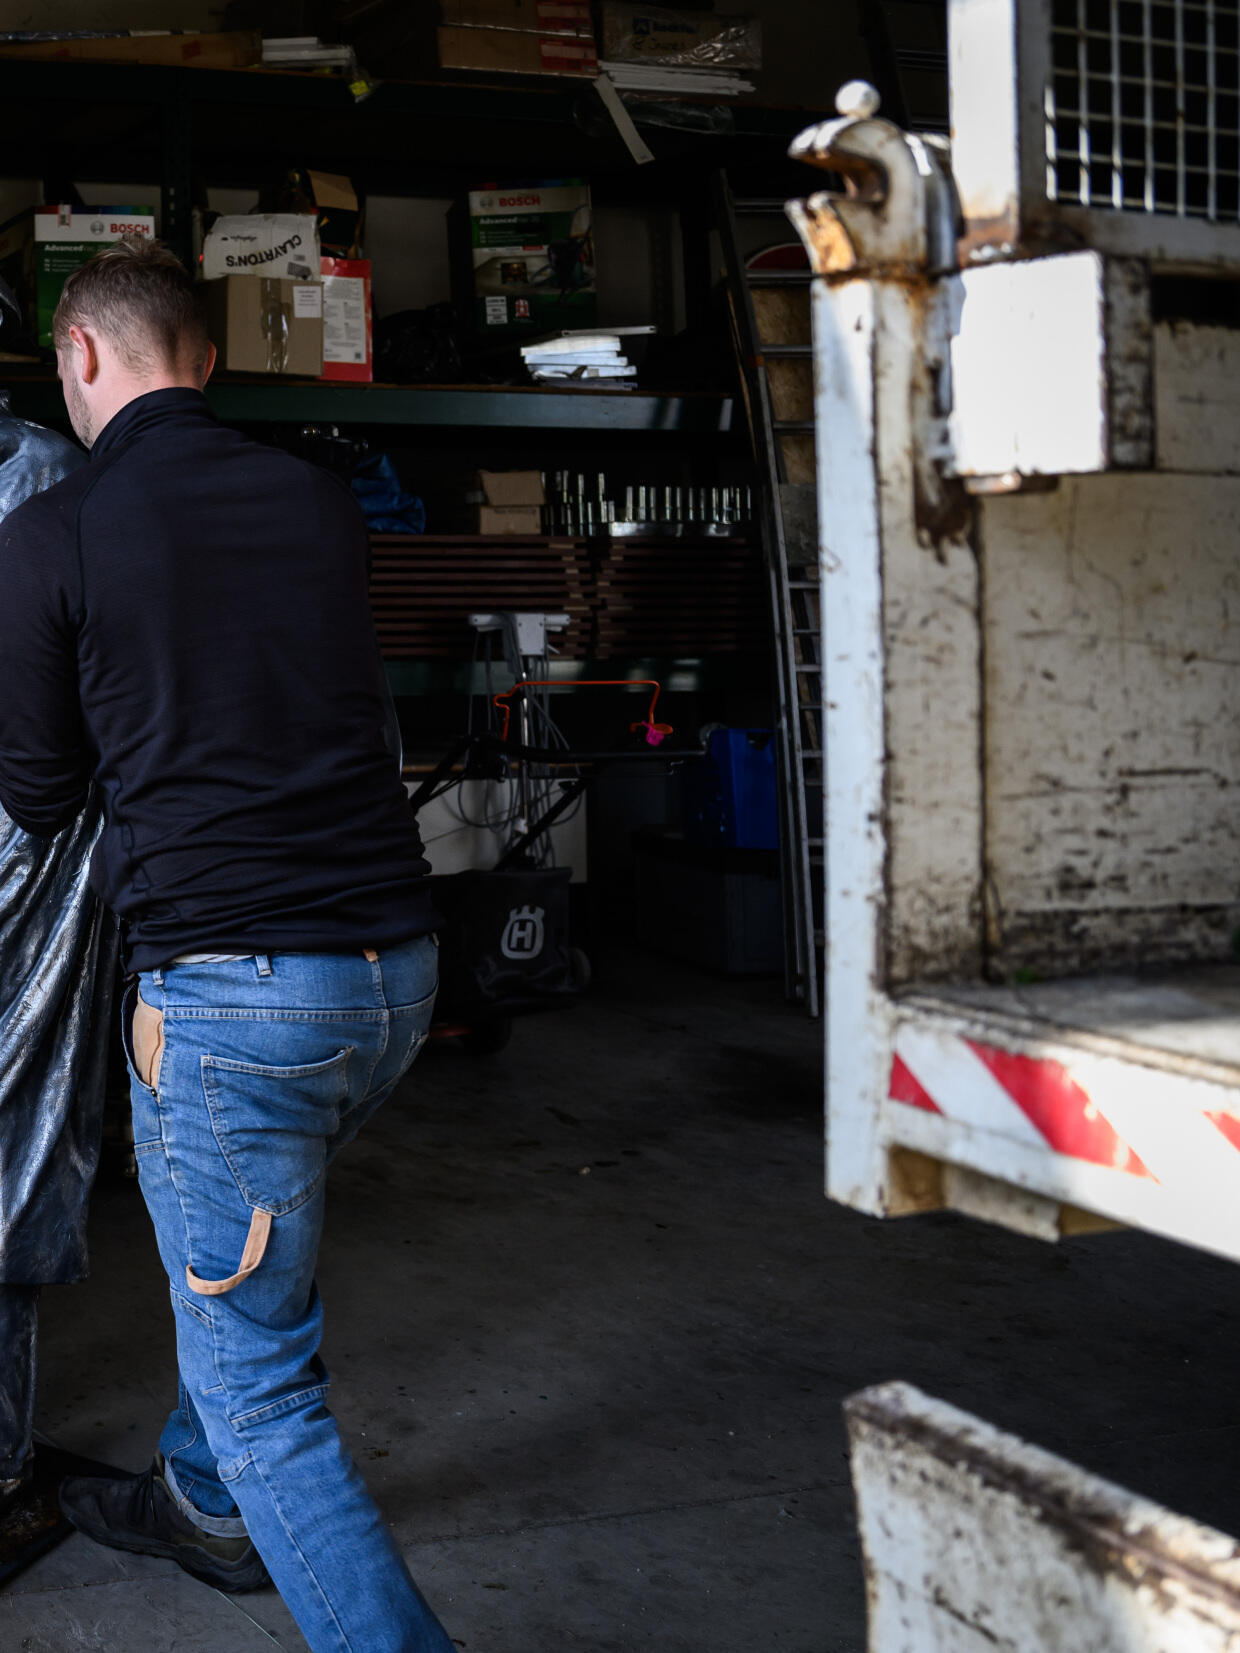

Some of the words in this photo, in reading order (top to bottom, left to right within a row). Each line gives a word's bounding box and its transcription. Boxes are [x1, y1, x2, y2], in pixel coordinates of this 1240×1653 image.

[499, 196, 541, 207] BOSCH
[110, 223, 150, 234] BOSCH
[225, 234, 302, 268] CLAYRTON'S
